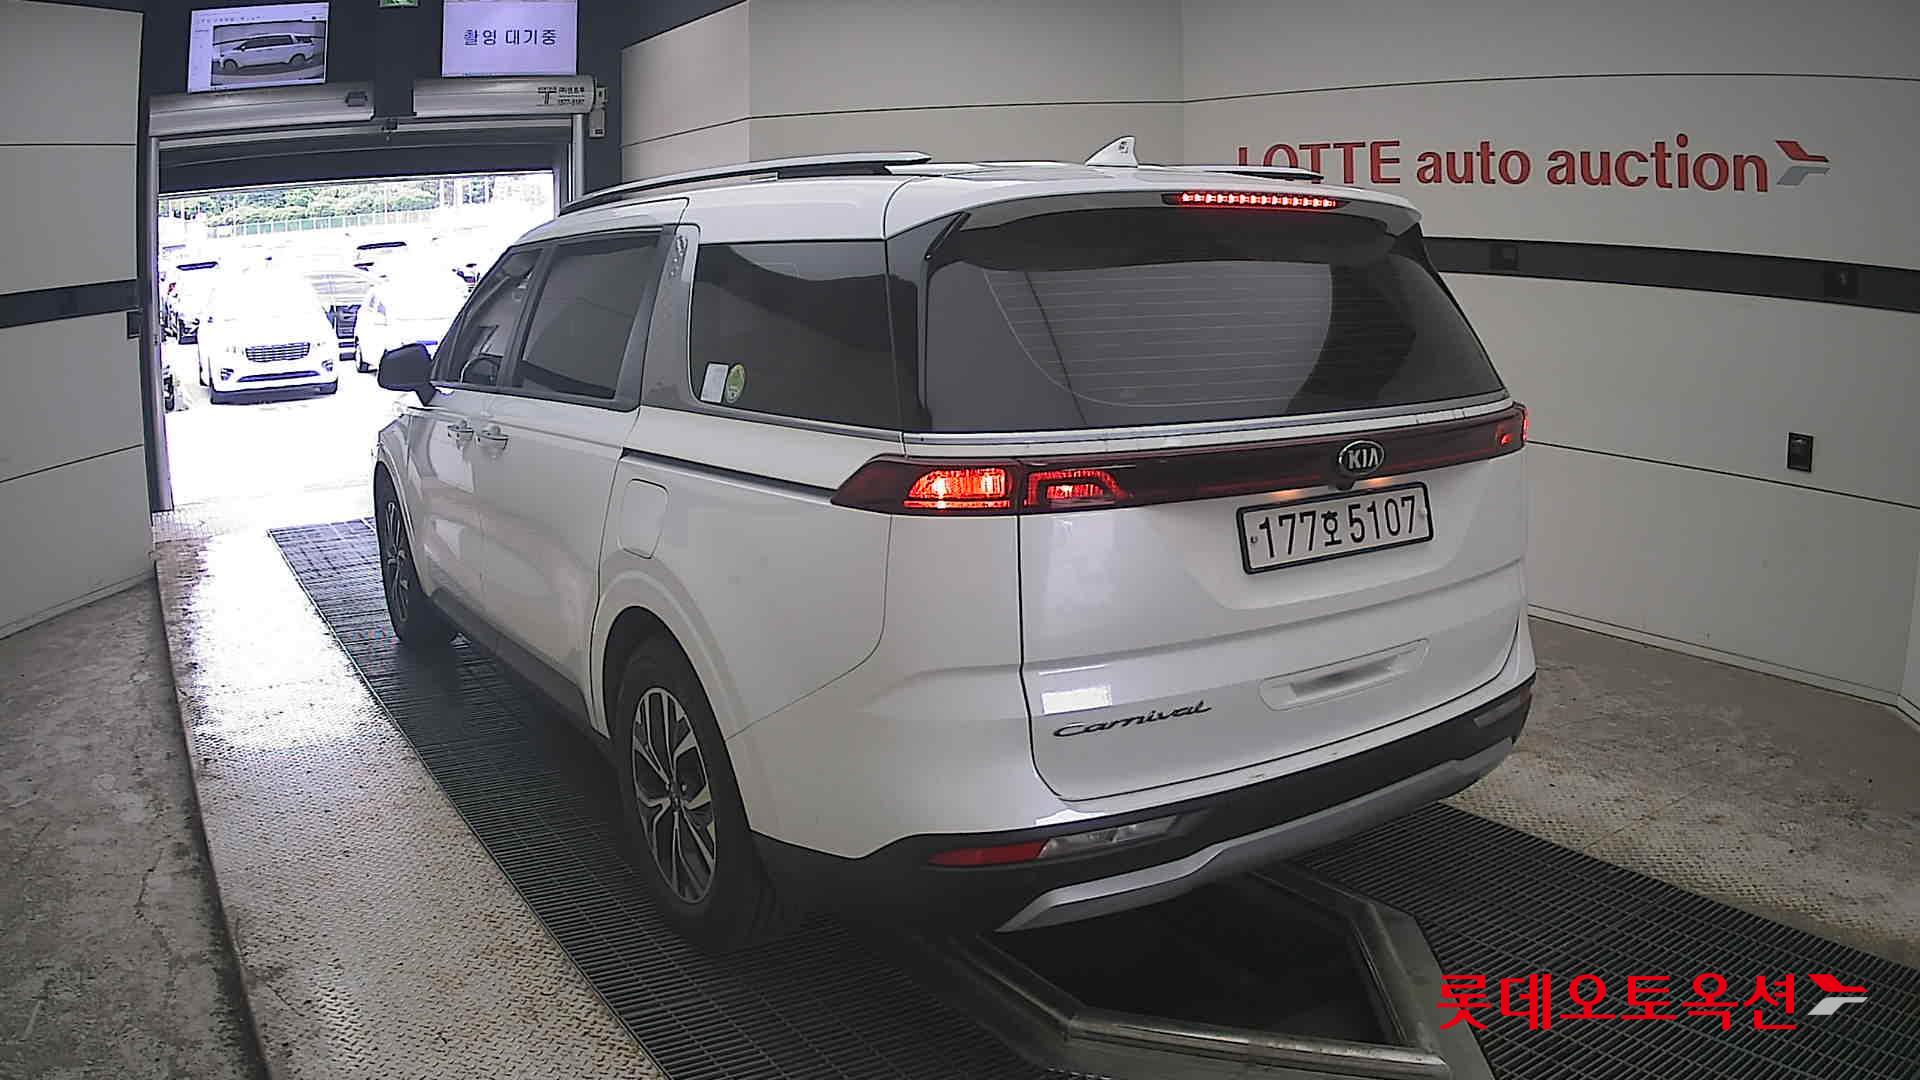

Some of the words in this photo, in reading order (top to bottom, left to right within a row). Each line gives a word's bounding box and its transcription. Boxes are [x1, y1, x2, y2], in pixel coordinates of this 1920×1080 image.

[464, 29, 497, 46] 촬영
[505, 29, 557, 46] 대기중
[1416, 141, 1531, 187] auto
[1547, 133, 1768, 193] auction
[1348, 447, 1379, 470] KIA
[1054, 699, 1212, 738] Carnival
